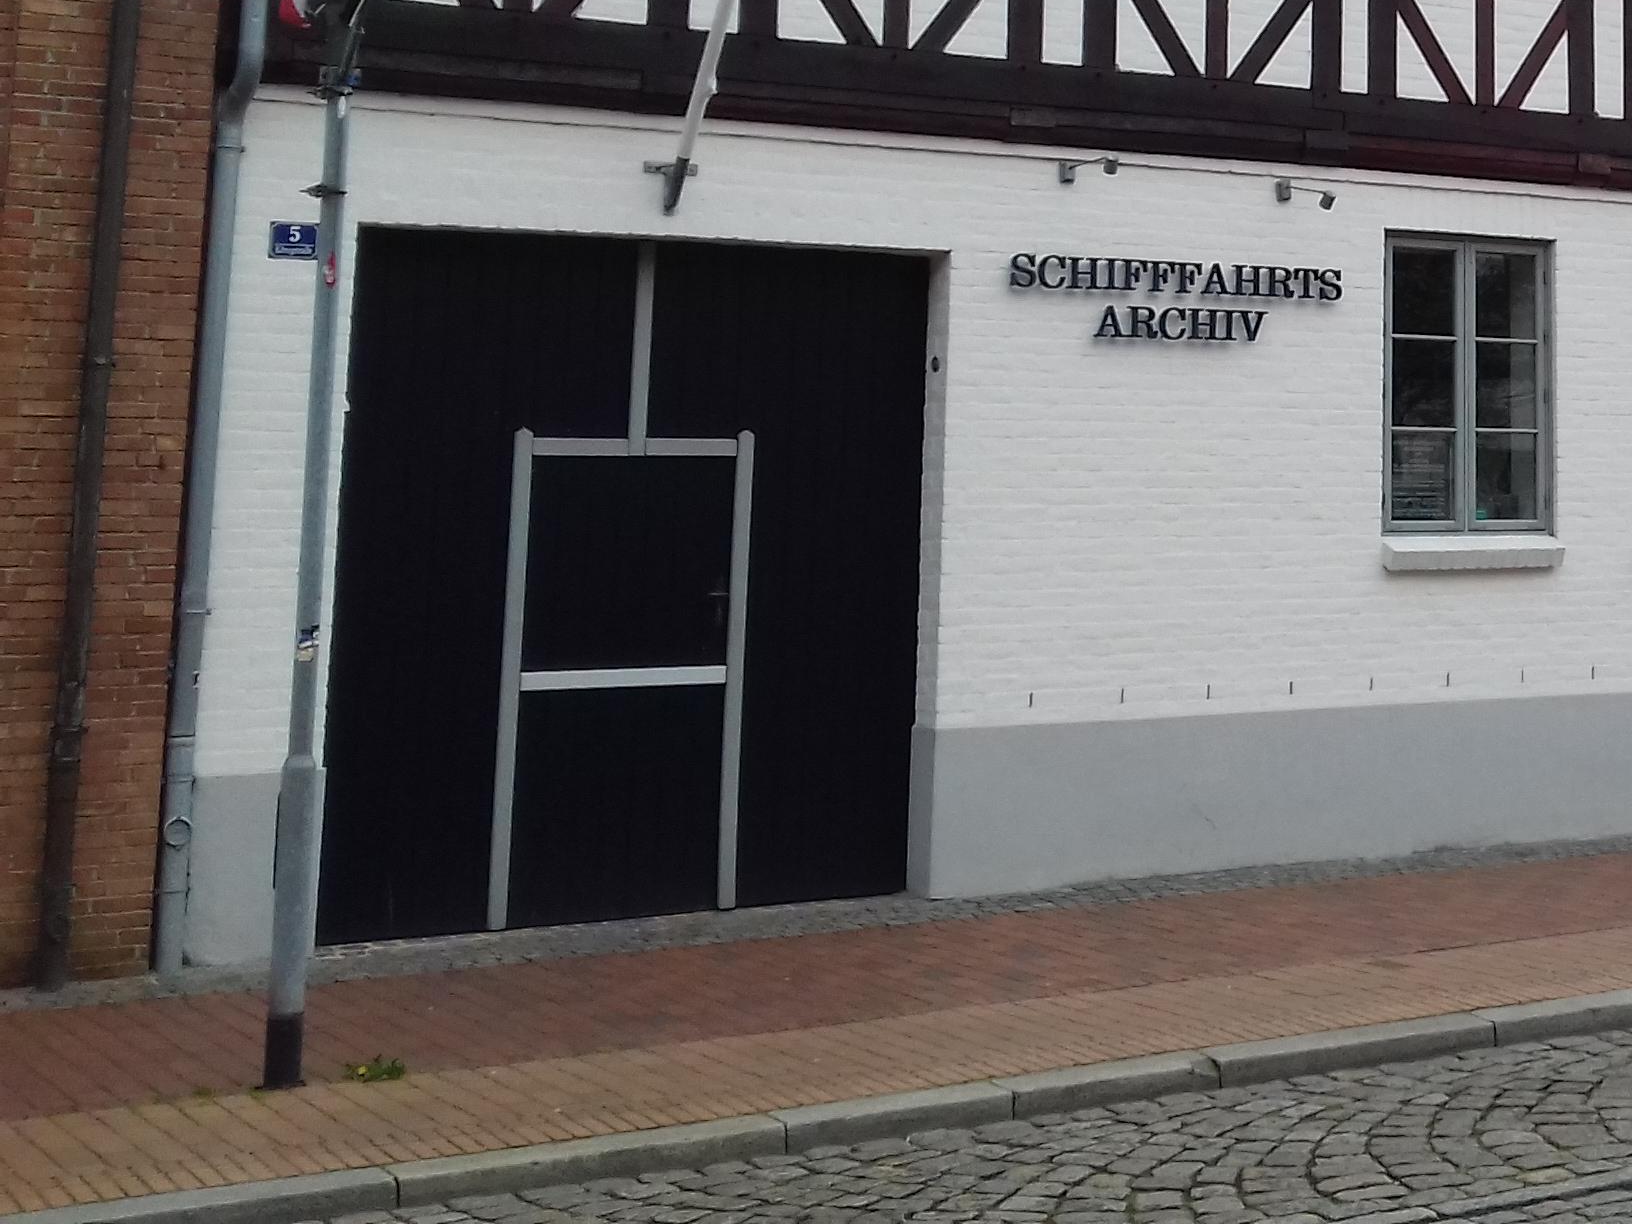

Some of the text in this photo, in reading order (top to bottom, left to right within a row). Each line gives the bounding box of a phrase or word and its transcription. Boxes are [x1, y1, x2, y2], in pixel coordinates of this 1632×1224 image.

[288, 225, 302, 243] 5
[1010, 253, 1343, 301] SCHIFFFAHRTS
[1094, 305, 1268, 342] ARCHIV
